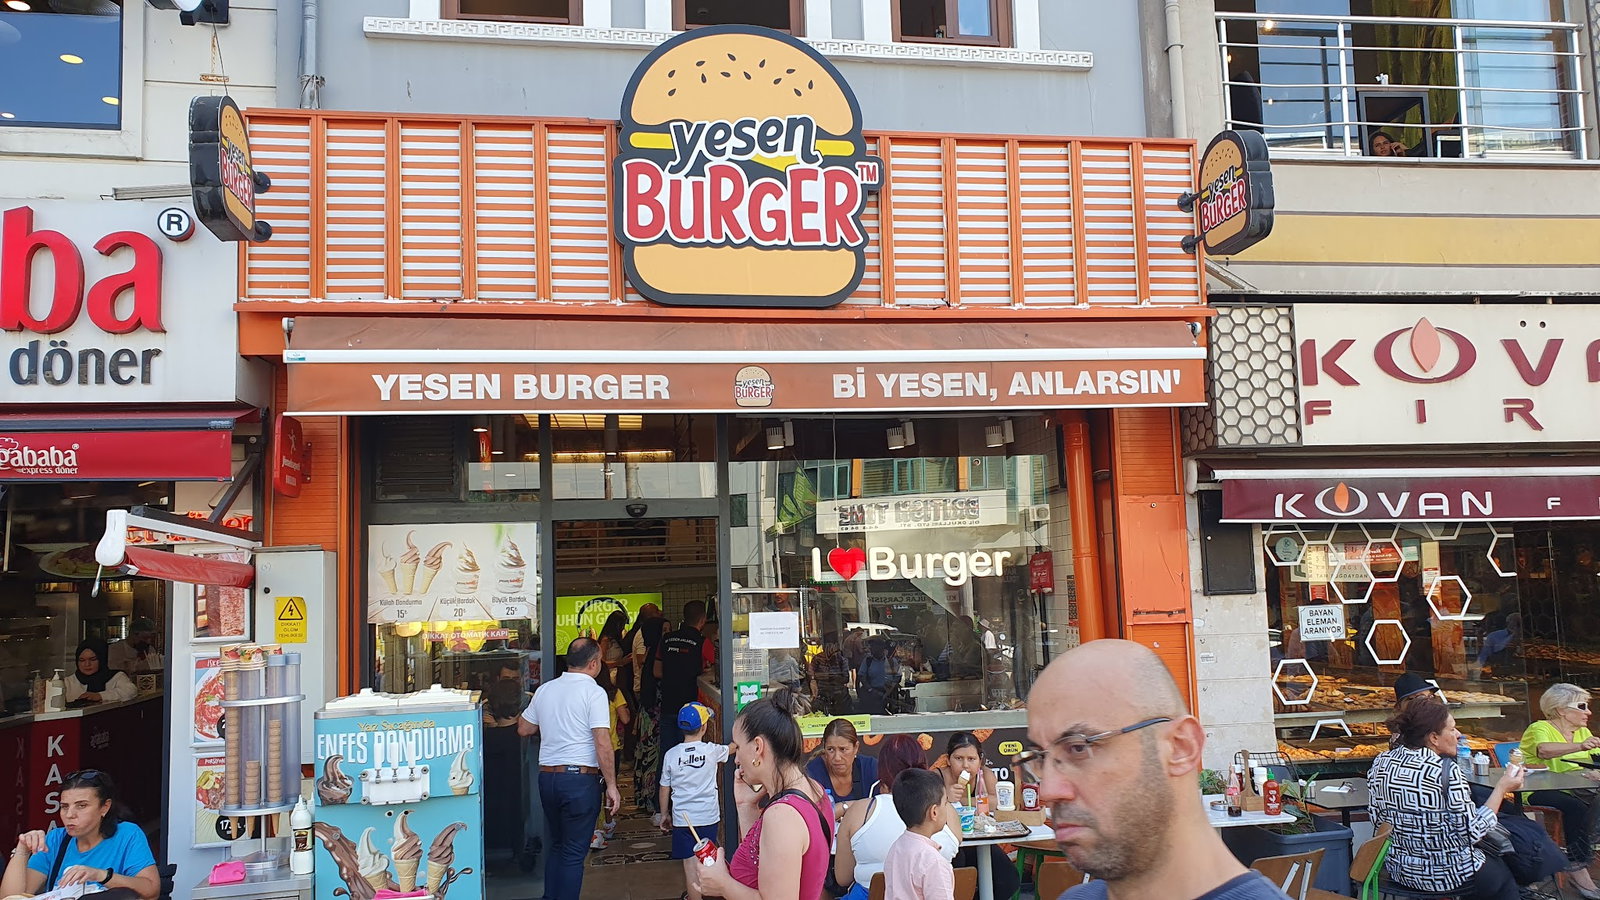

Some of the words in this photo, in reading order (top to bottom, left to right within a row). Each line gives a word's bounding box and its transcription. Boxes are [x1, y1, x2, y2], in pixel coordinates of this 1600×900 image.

[667, 117, 821, 175] yesen
[9, 340, 163, 385] döner
[371, 373, 501, 401] YESEN
[514, 374, 670, 400] BURGER
[876, 372, 998, 402] YESEN,
[1008, 369, 1181, 396] ANLARSIN'
[22, 467, 53, 475] express
[55, 466, 79, 475] döner
[1275, 486, 1493, 518] KOVAN
[869, 546, 1012, 586] Burger
[1306, 618, 1338, 626] ELEMAN
[1309, 609, 1334, 617] BAYAN
[1304, 625, 1342, 634] ARANIYOR
[358, 722, 378, 732] Yaz
[317, 731, 368, 763] ENFES
